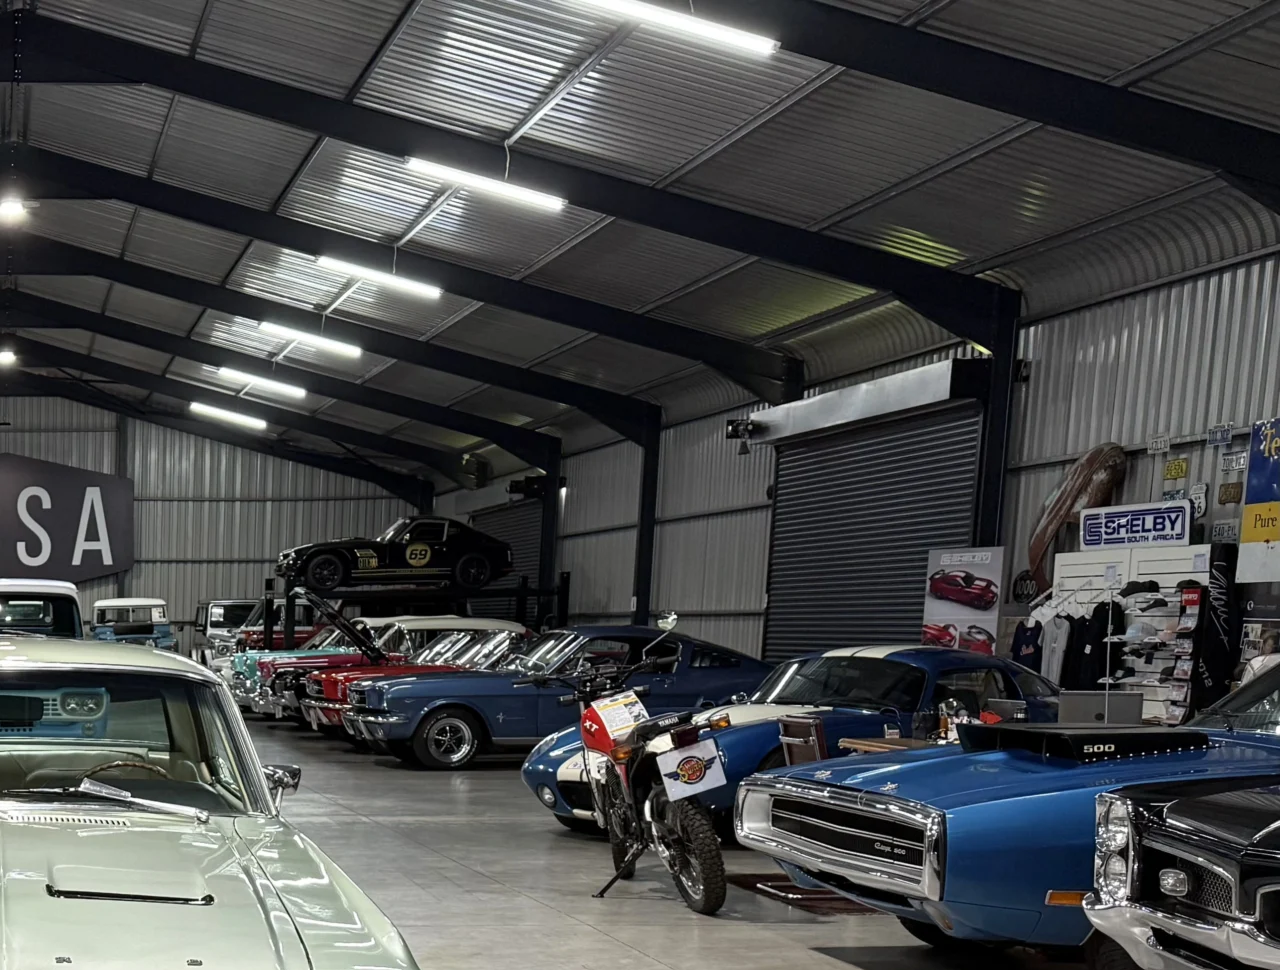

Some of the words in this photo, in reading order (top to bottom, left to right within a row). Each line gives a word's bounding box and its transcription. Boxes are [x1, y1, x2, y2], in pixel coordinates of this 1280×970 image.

[1104, 514, 1180, 536] SHELBY
[1254, 513, 1278, 529] Pure
[1127, 535, 1149, 543] SOUTH
[1152, 533, 1175, 542] AFRICA
[409, 549, 429, 560] 69
[583, 719, 600, 732] XT
[657, 716, 680, 727] YAMAHA
[1083, 744, 1115, 753] 500
